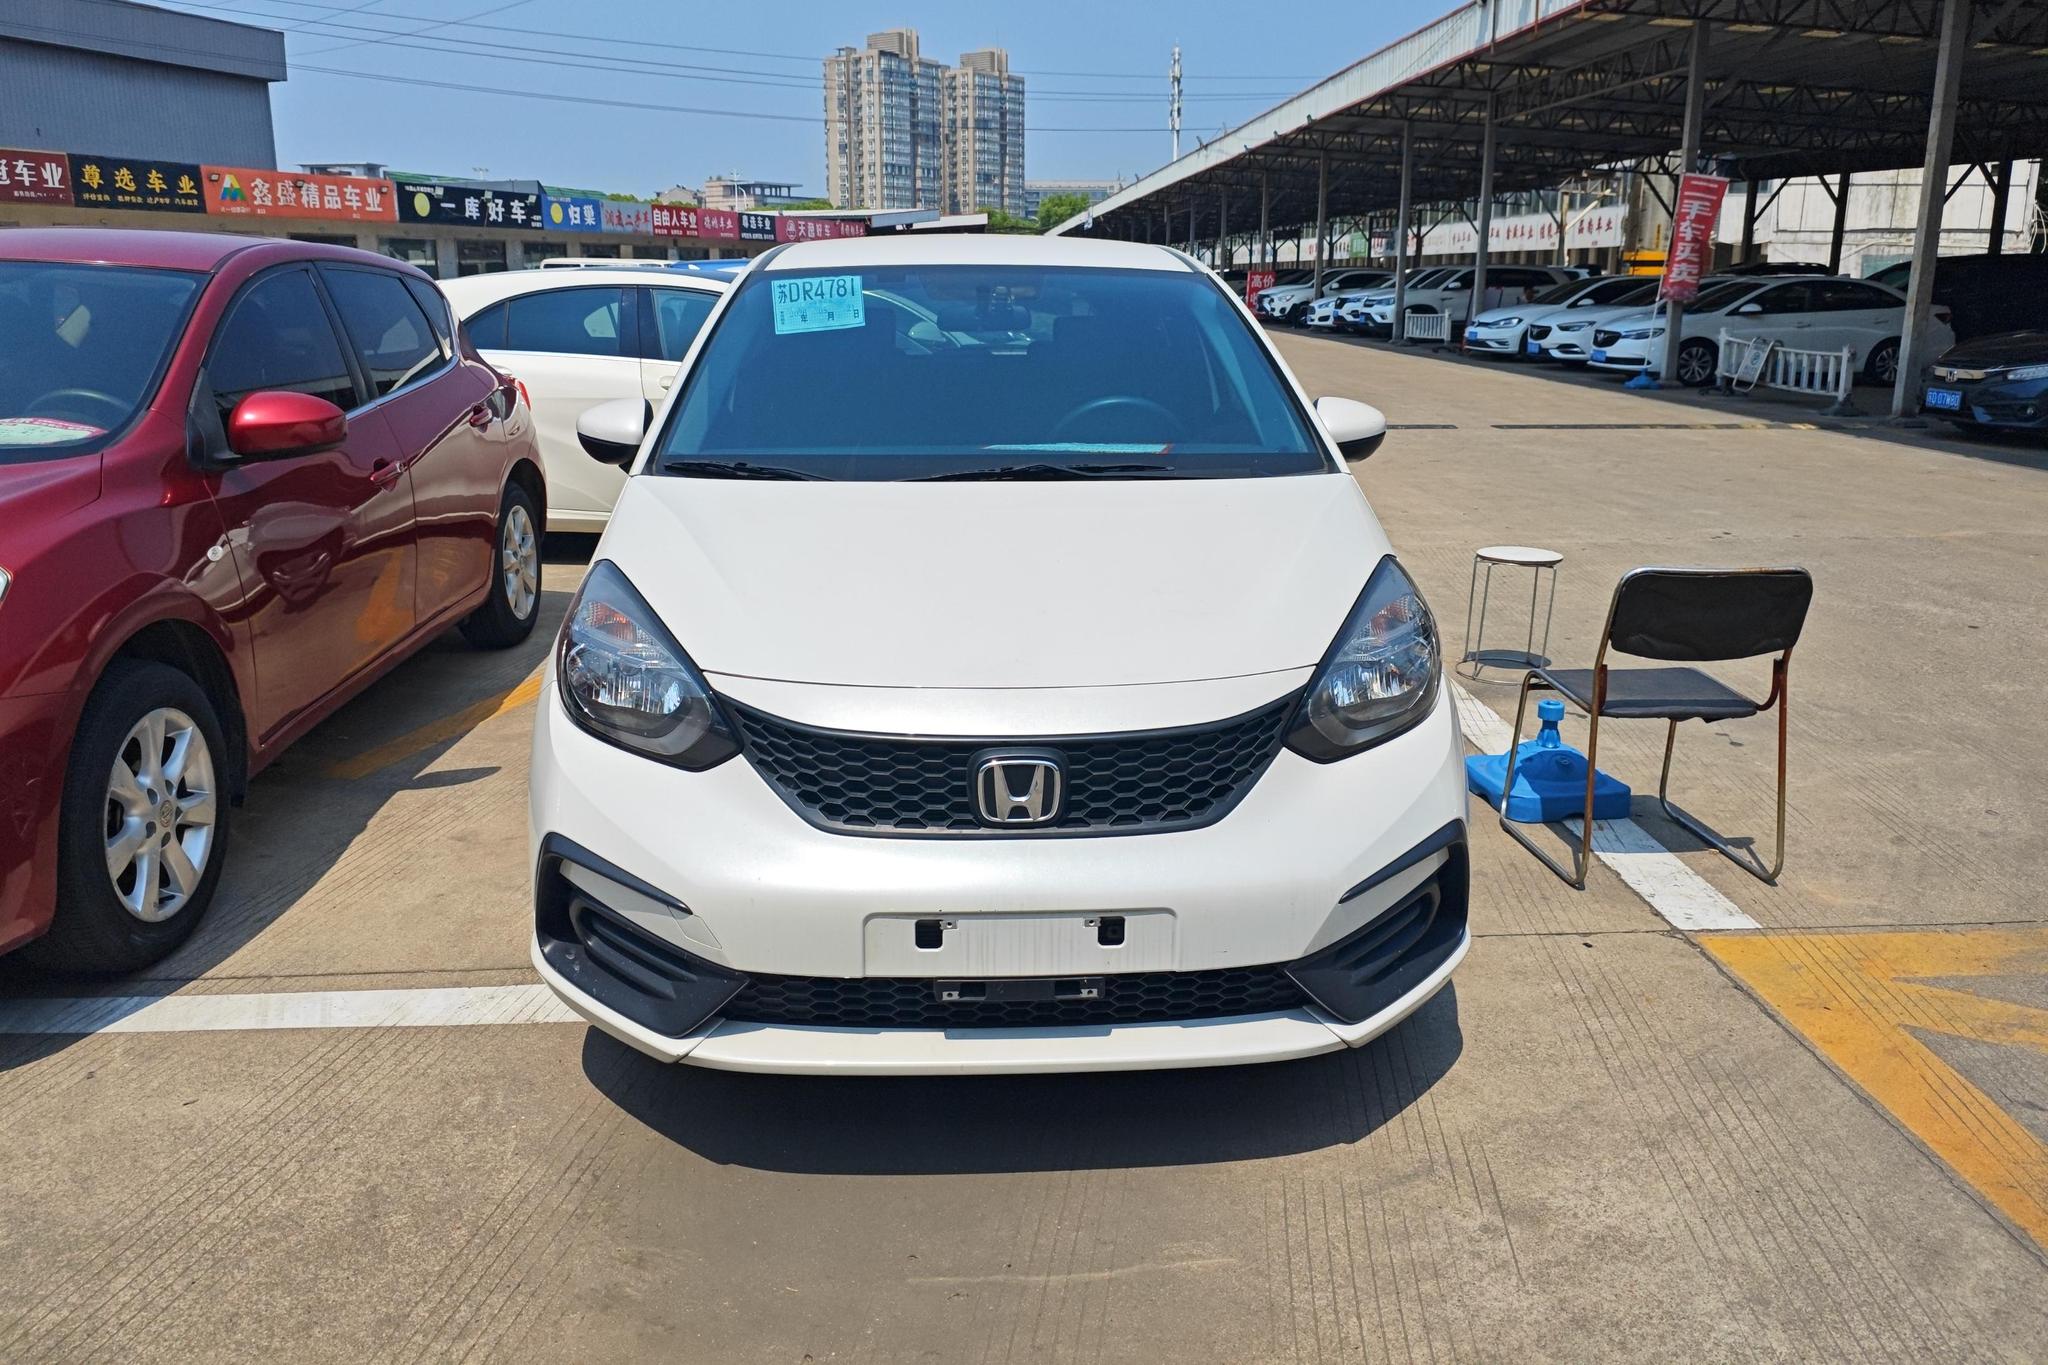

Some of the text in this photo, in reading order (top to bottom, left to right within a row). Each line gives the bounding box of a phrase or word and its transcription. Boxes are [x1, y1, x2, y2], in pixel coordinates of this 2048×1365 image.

[81, 164, 198, 195] 尊选车业
[251, 177, 383, 212] 鑫盛精品车业
[440, 196, 527, 224] 一库好车
[568, 204, 596, 226] 归巢
[653, 207, 698, 229] 自由人车业
[1669, 181, 1718, 283] 二手车买卖
[777, 277, 855, 304] 苏DR4781
[1251, 274, 1275, 288] 高价
[828, 311, 835, 321] 月
[854, 308, 860, 318] 日
